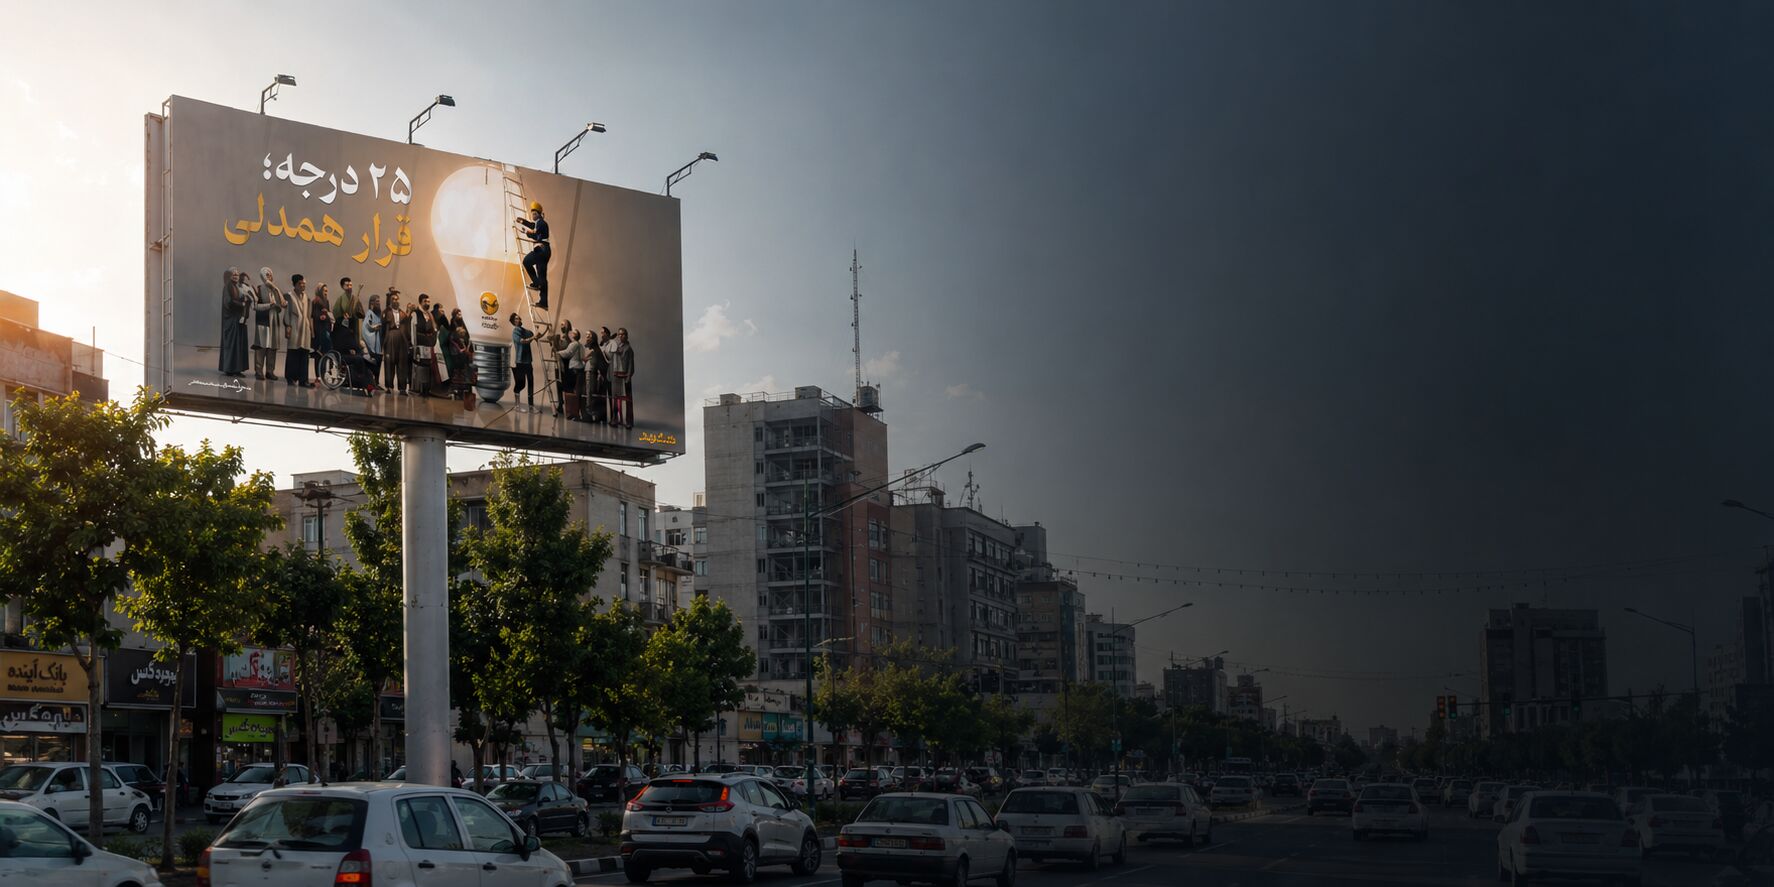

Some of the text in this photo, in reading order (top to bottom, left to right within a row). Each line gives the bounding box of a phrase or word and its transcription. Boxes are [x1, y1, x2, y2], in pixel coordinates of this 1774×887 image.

[262, 152, 413, 205] ۲۵ درجه؛
[223, 192, 413, 268] قرار همدلی
[7, 658, 68, 687] بانک آینده
